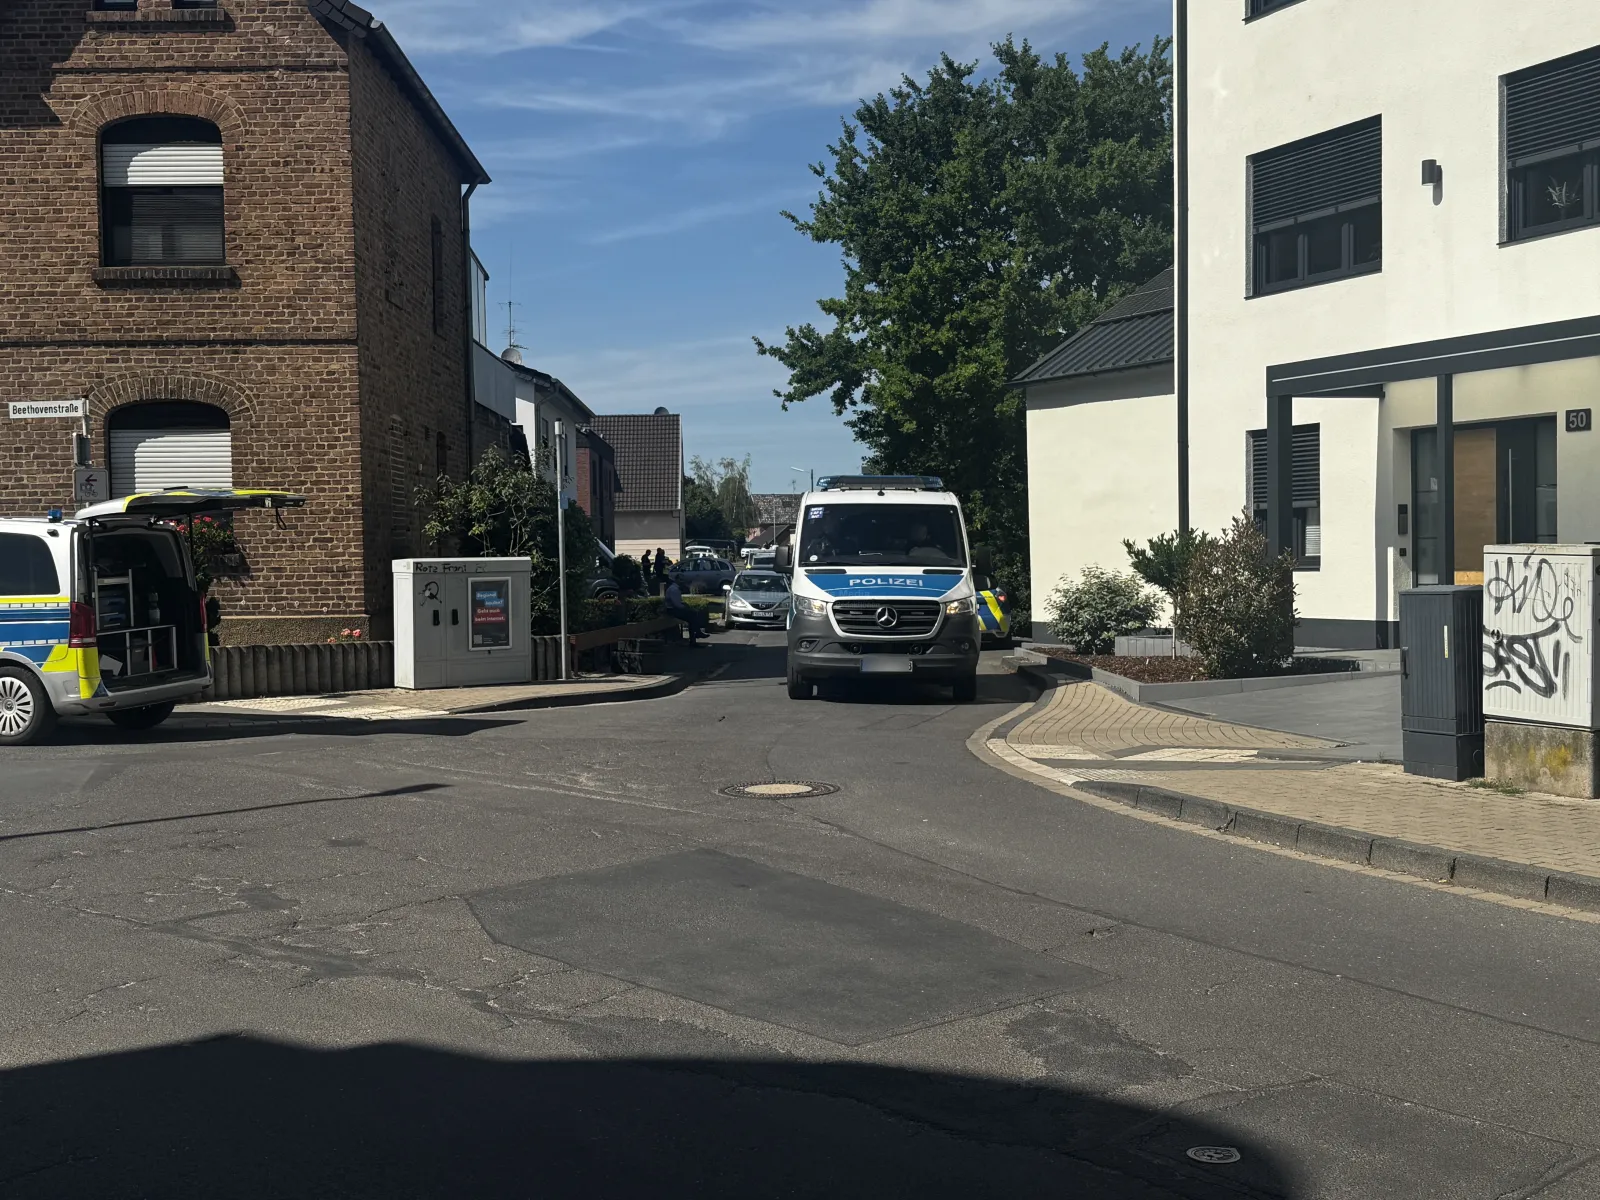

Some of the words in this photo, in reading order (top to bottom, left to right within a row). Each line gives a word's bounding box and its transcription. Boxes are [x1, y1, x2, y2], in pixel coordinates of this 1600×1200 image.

[12, 403, 79, 414] Beethovenstraße
[1569, 411, 1587, 428] 50
[849, 578, 923, 587] POLIZEI
